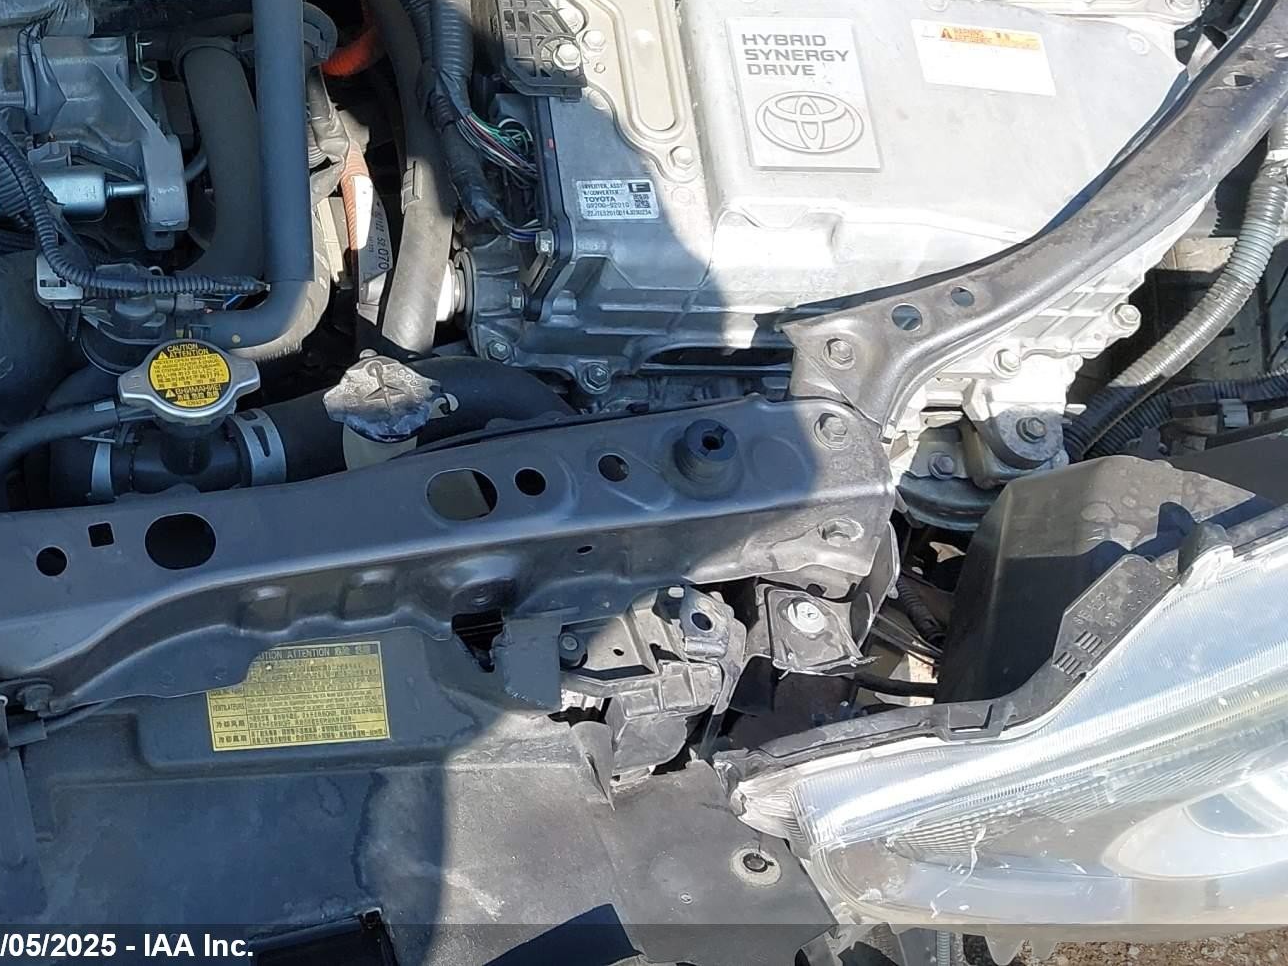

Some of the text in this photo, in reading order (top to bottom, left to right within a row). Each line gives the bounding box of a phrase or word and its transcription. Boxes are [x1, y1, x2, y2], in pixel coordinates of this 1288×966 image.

[742, 34, 827, 47] HYBRID
[744, 49, 849, 62] SYNERGY
[747, 64, 816, 76] DRIVE
[167, 343, 198, 352] CAUTION
[169, 348, 209, 358] ATTENTION
[288, 648, 330, 659] ATTENTION
